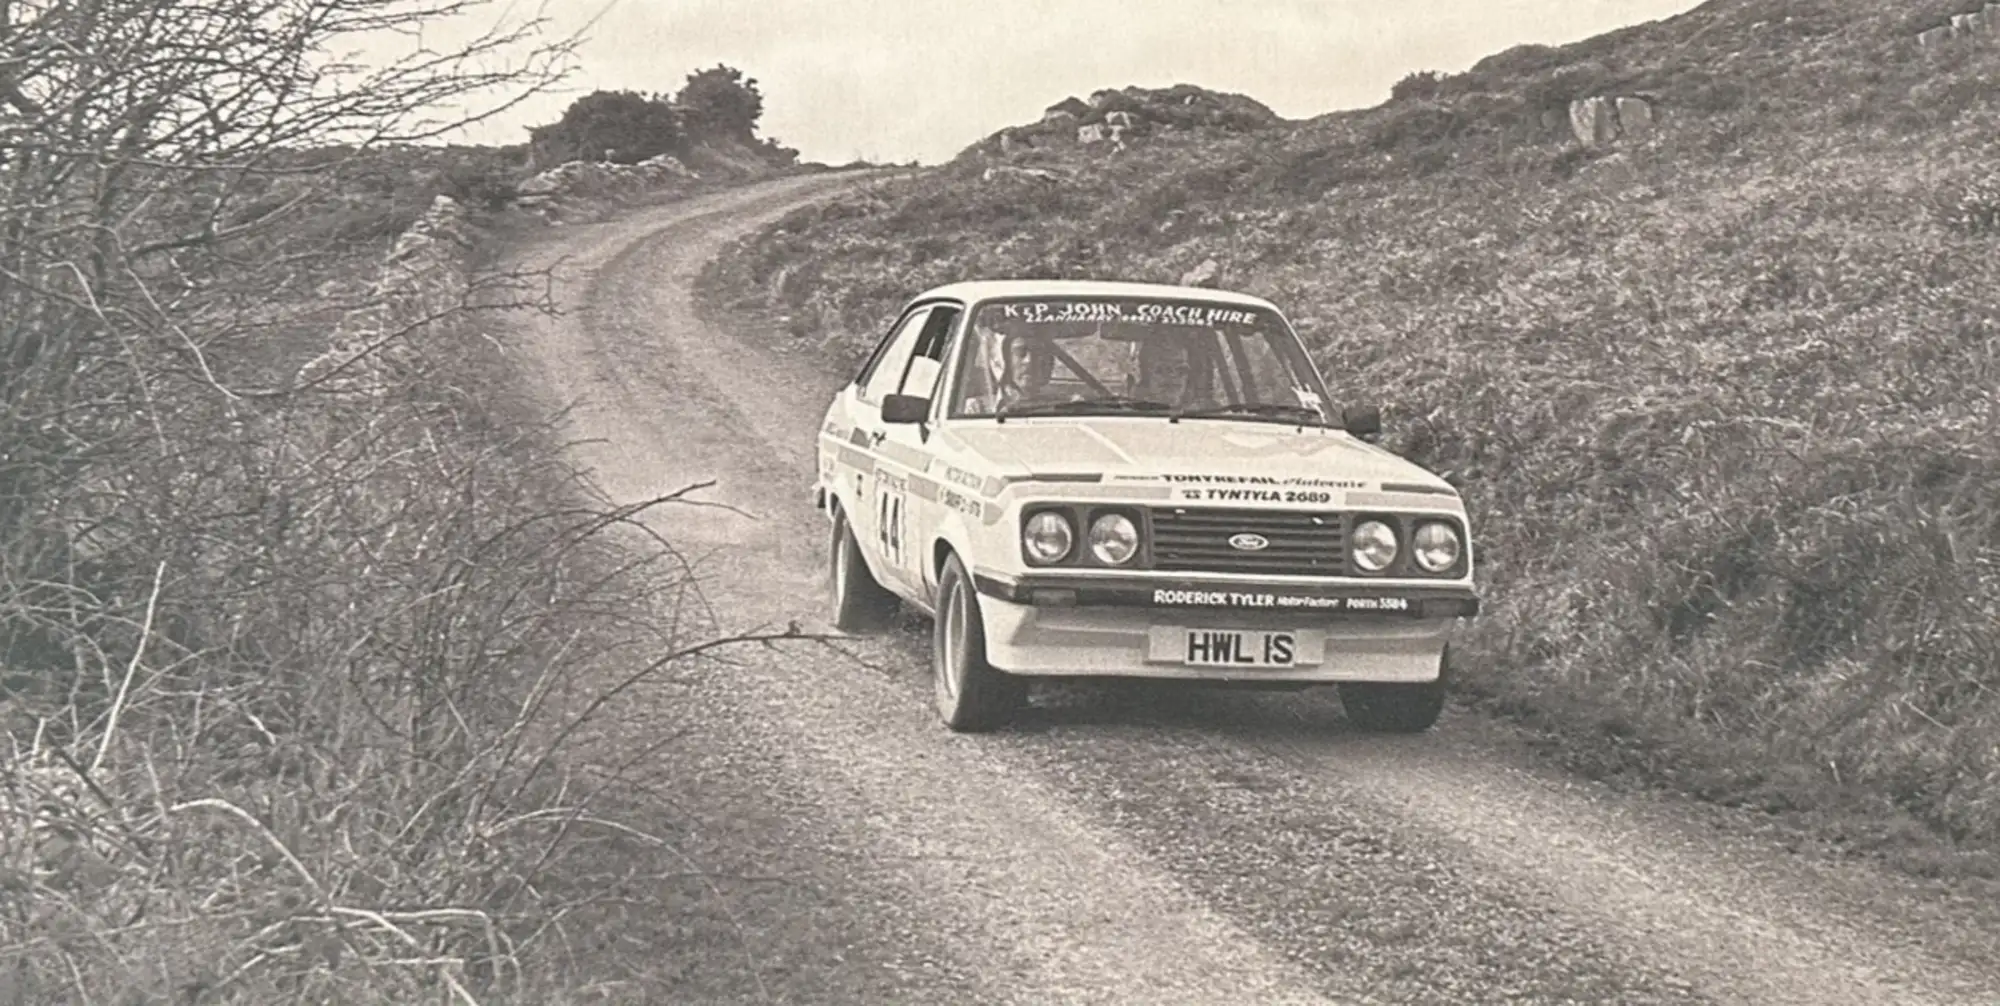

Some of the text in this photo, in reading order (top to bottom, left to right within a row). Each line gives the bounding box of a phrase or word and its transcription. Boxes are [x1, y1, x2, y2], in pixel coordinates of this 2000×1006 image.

[1059, 303, 1122, 318] JOHN
[1137, 304, 1203, 320] COACH
[1206, 308, 1257, 324] HIRE
[1206, 488, 1331, 503] TYNTYLA 2689
[1154, 588, 1227, 605] RODERICK
[1229, 592, 1275, 607] TYLER
[1188, 632, 1255, 663] HWL
